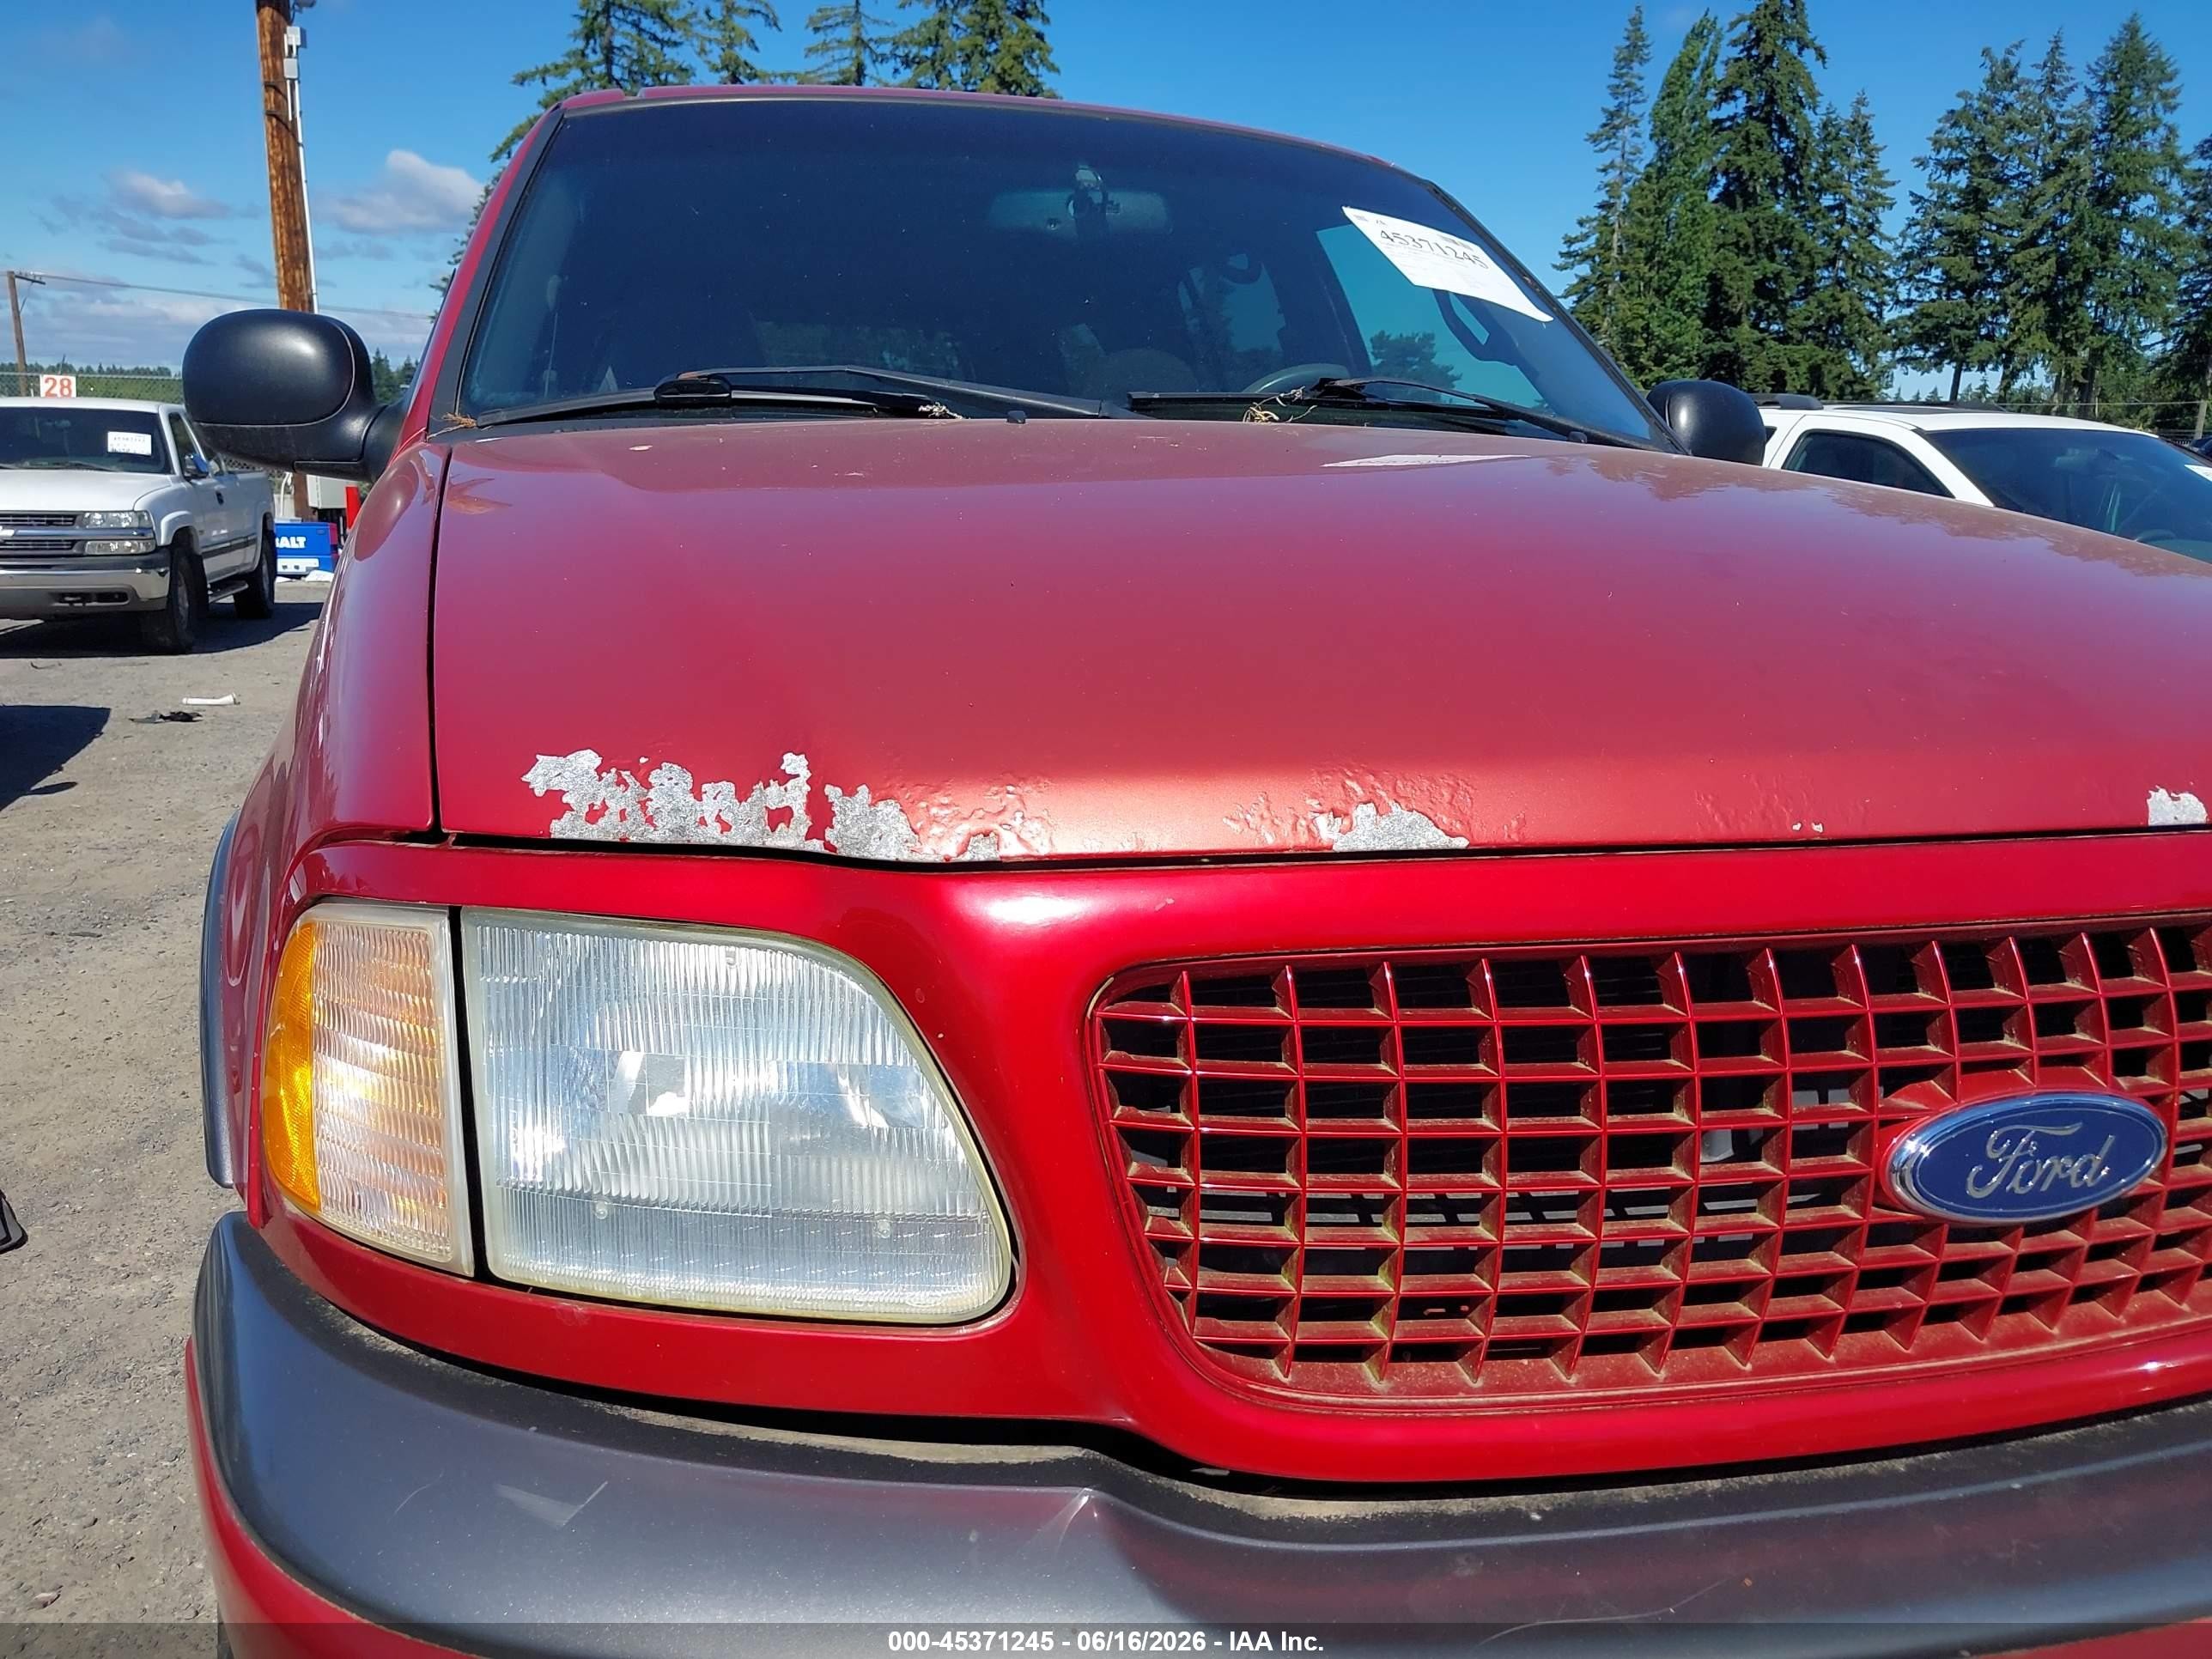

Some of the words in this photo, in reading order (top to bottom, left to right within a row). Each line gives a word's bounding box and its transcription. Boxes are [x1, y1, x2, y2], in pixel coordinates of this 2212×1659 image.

[1380, 229, 1489, 270] 45371245
[44, 377, 72, 398] 28
[1966, 1121, 2116, 1200] Ford
